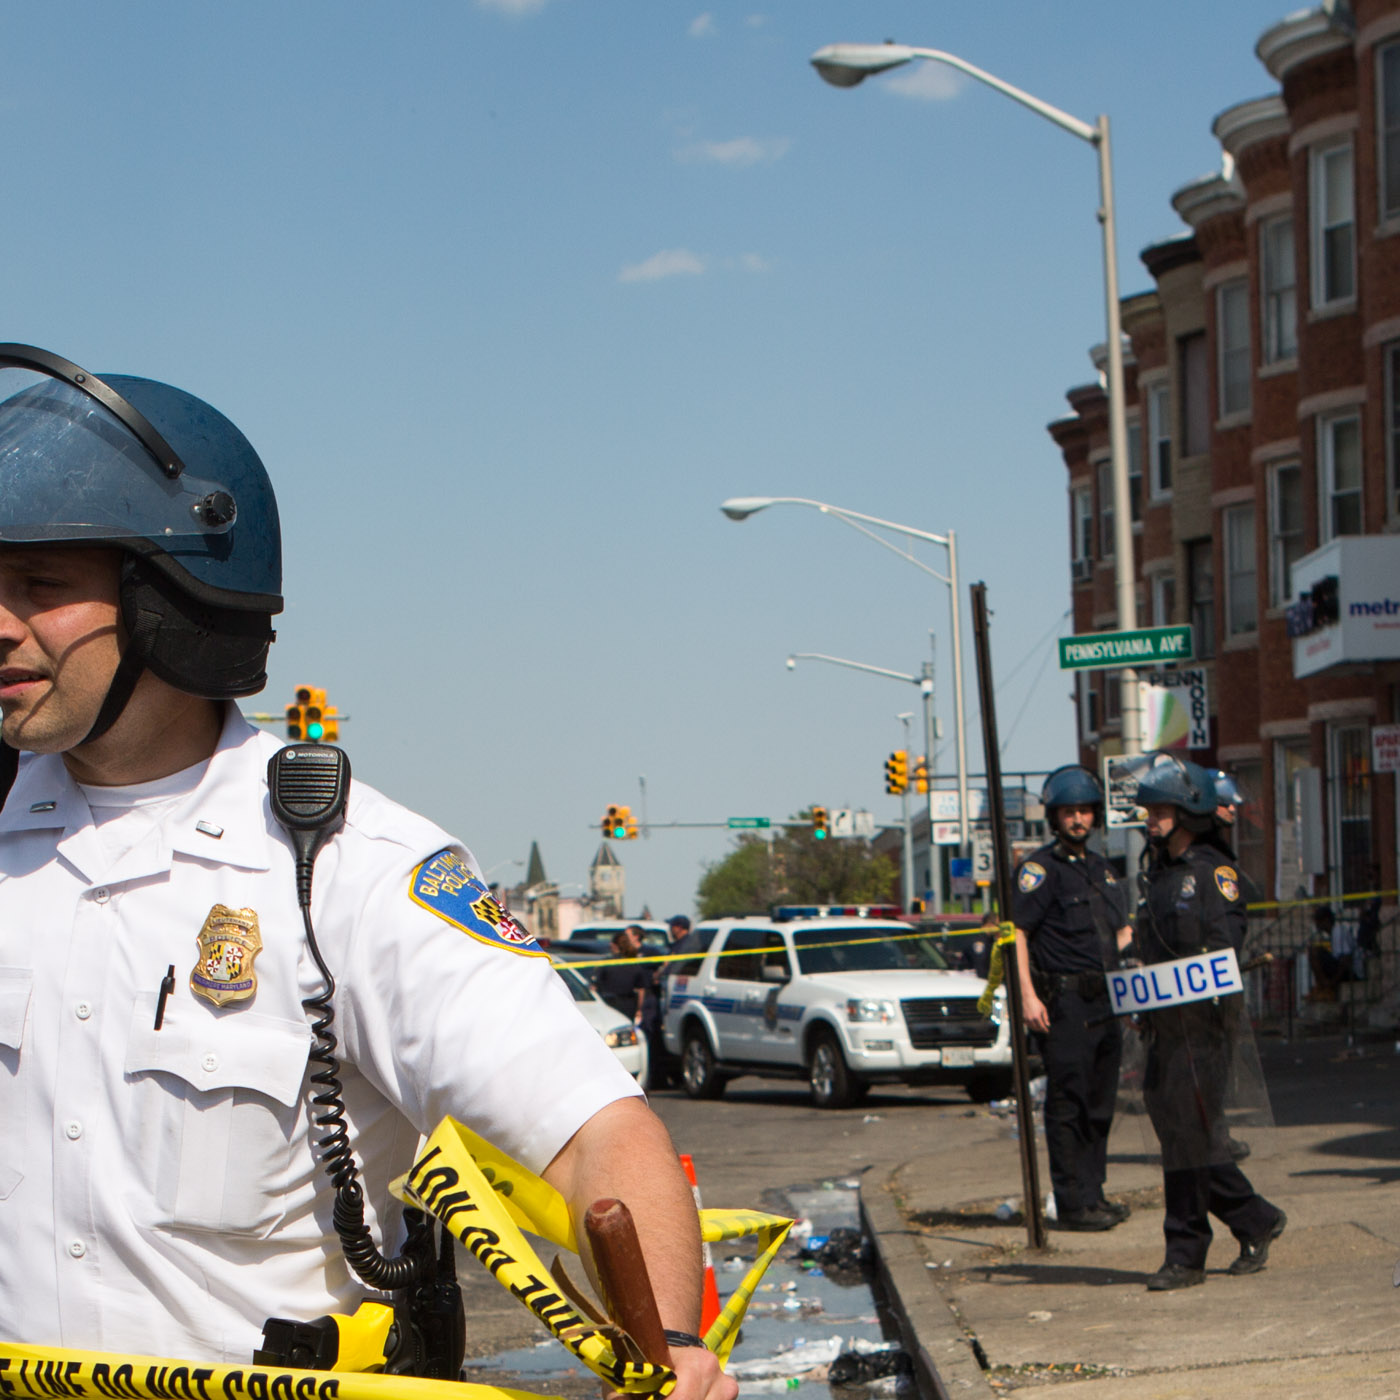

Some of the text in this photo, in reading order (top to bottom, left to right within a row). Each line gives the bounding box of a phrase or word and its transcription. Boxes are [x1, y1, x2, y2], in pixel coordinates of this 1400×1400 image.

[1065, 639, 1154, 661] PENNSYLVANIA
[209, 935, 247, 947] POLICE
[1112, 956, 1234, 1008] POLICE
[19, 1359, 87, 1400] LINE
[91, 1362, 150, 1400] DO
